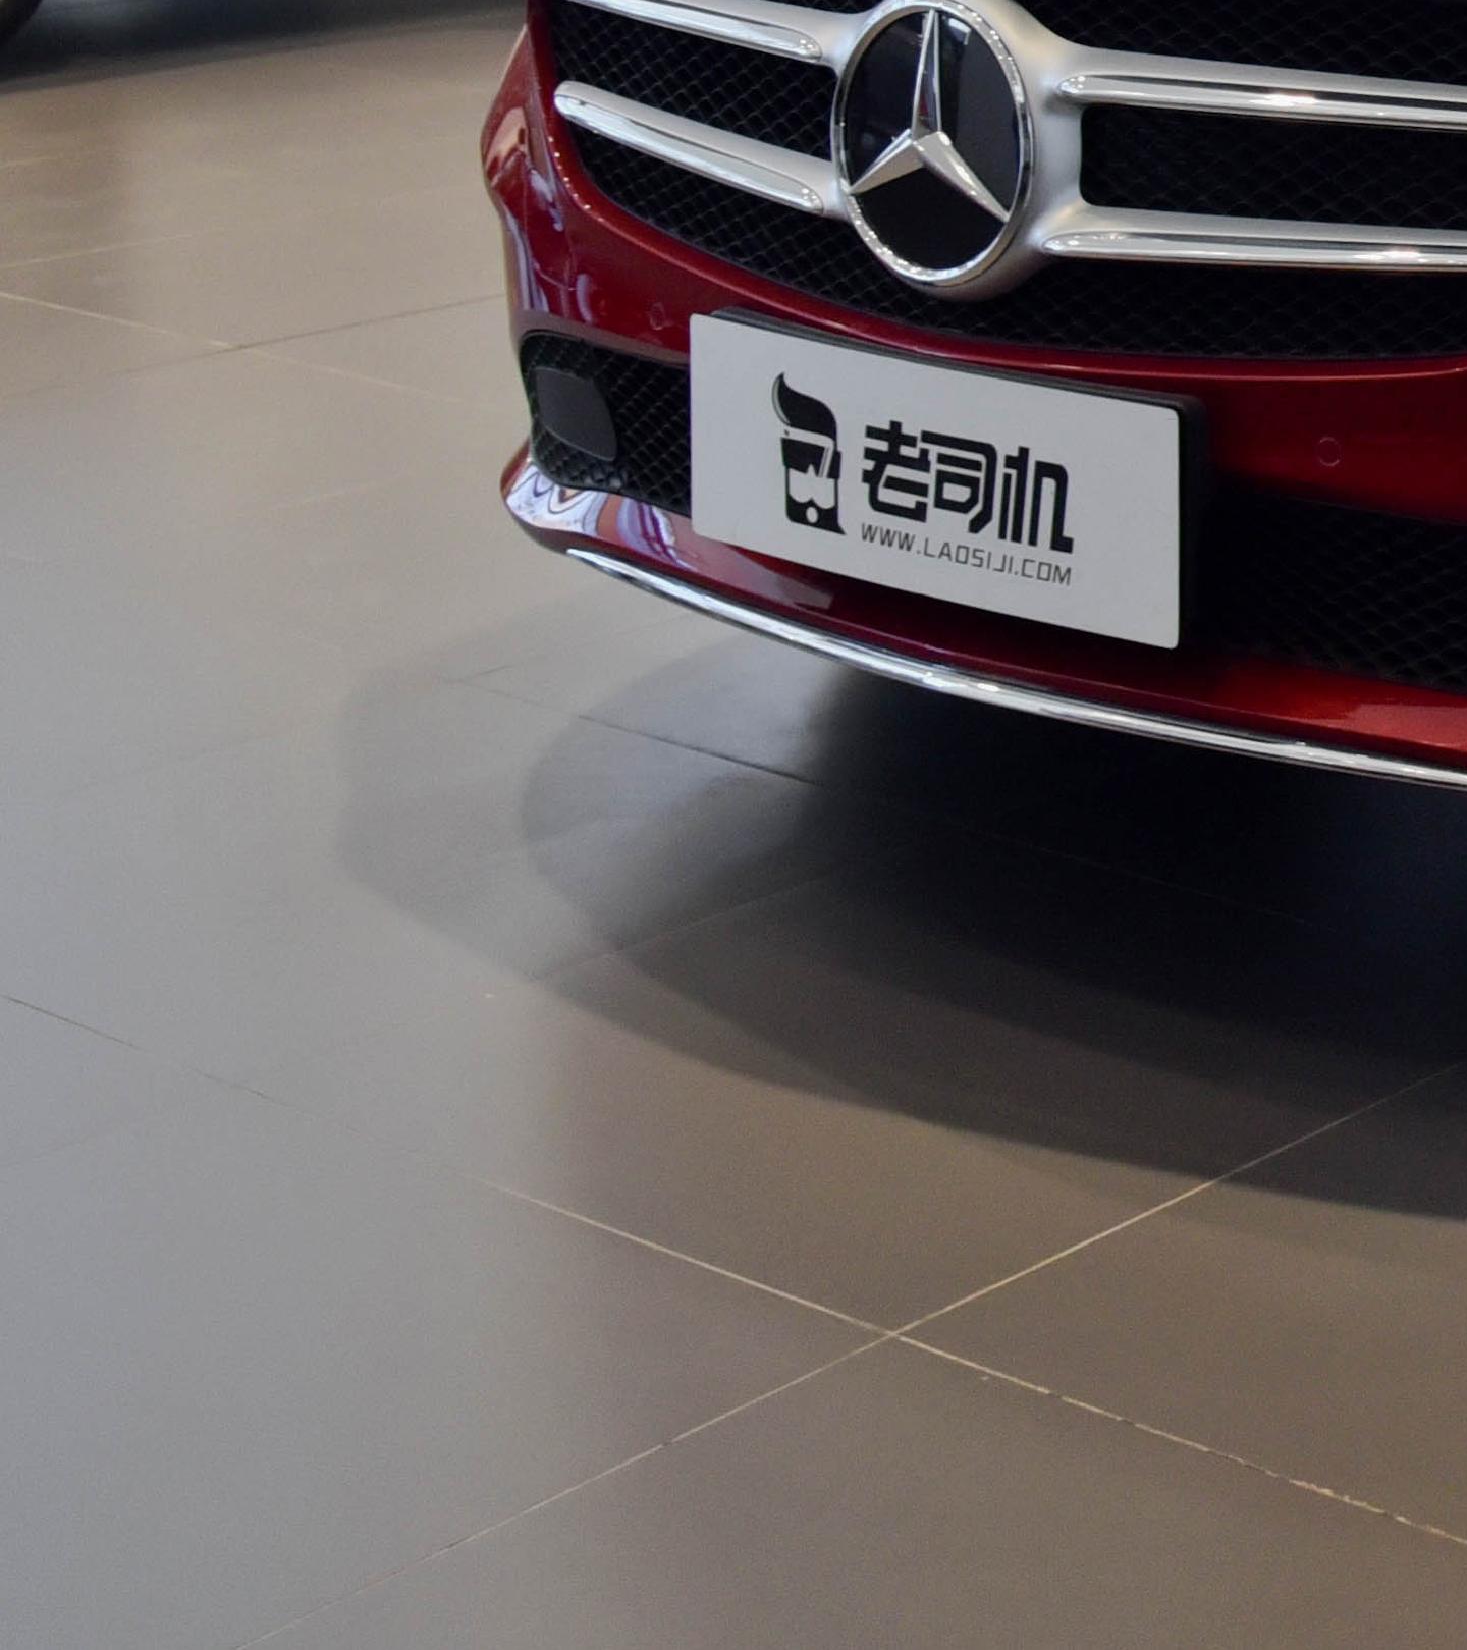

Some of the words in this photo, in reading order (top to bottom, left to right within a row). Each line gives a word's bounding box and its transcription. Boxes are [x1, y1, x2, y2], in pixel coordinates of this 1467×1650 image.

[861, 420, 1074, 554] 老司机
[861, 522, 1072, 587] WWW.LAOSIJI.COM
